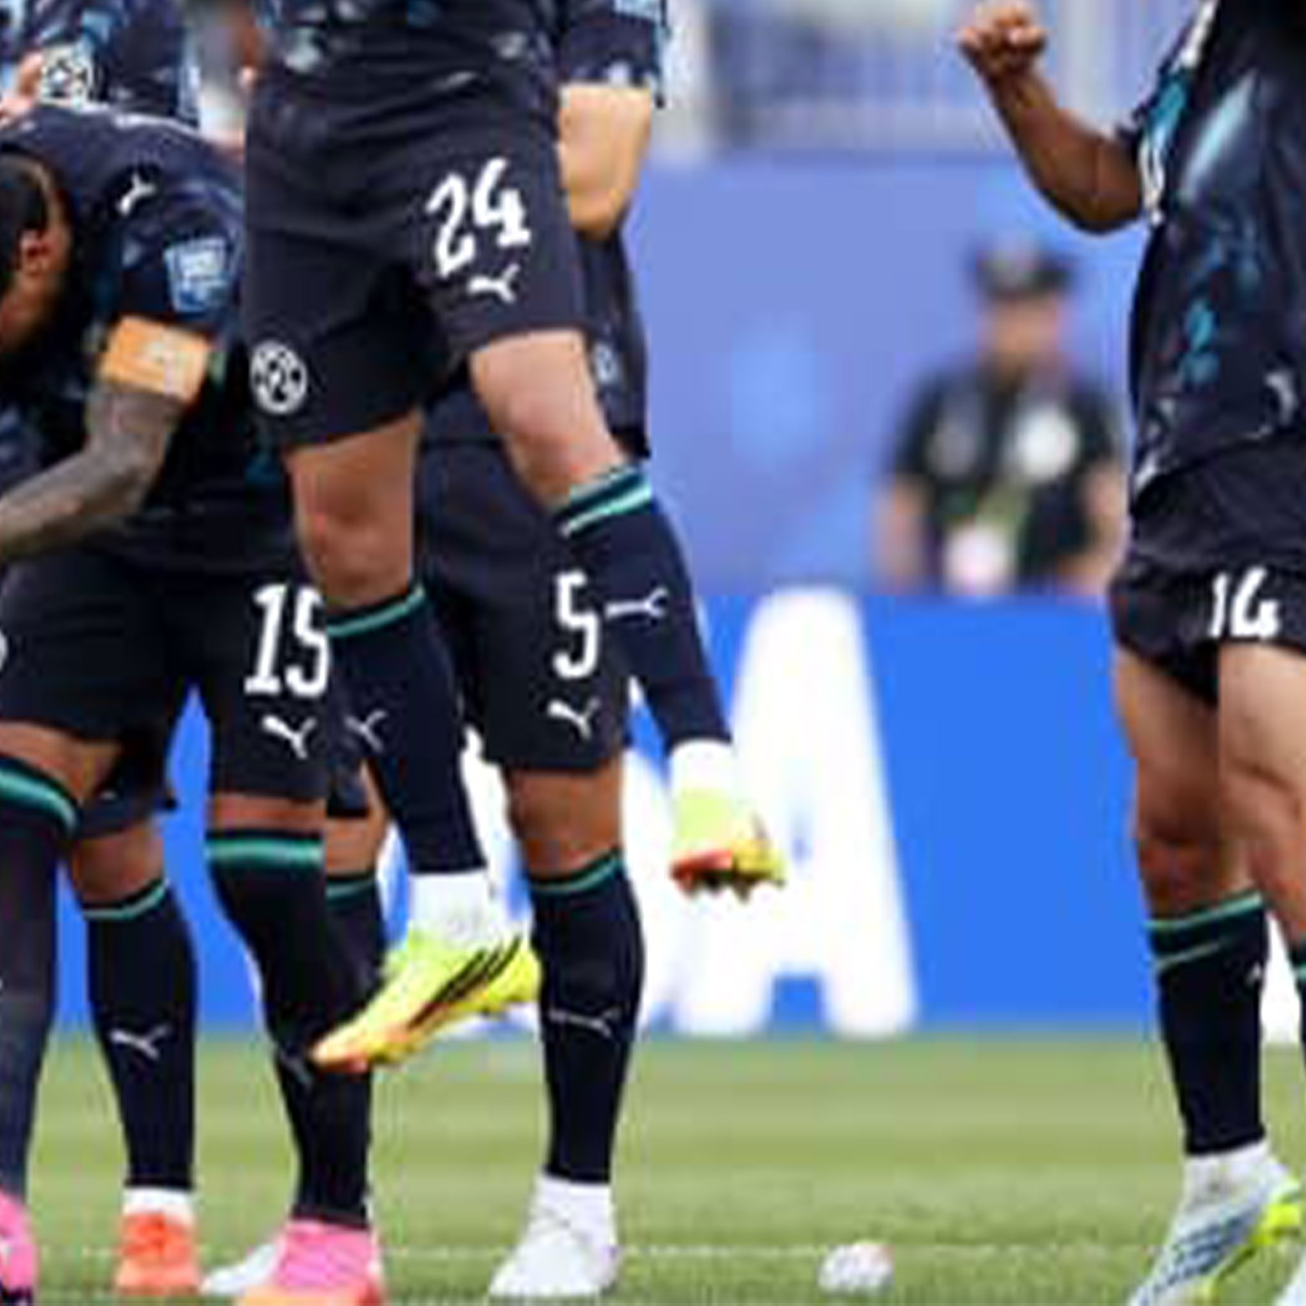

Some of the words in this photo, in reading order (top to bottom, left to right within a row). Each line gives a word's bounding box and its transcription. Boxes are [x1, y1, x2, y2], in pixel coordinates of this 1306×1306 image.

[424, 157, 531, 278] 24
[244, 584, 330, 698] 15
[552, 568, 600, 679] 5
[1208, 565, 1281, 639] 14
